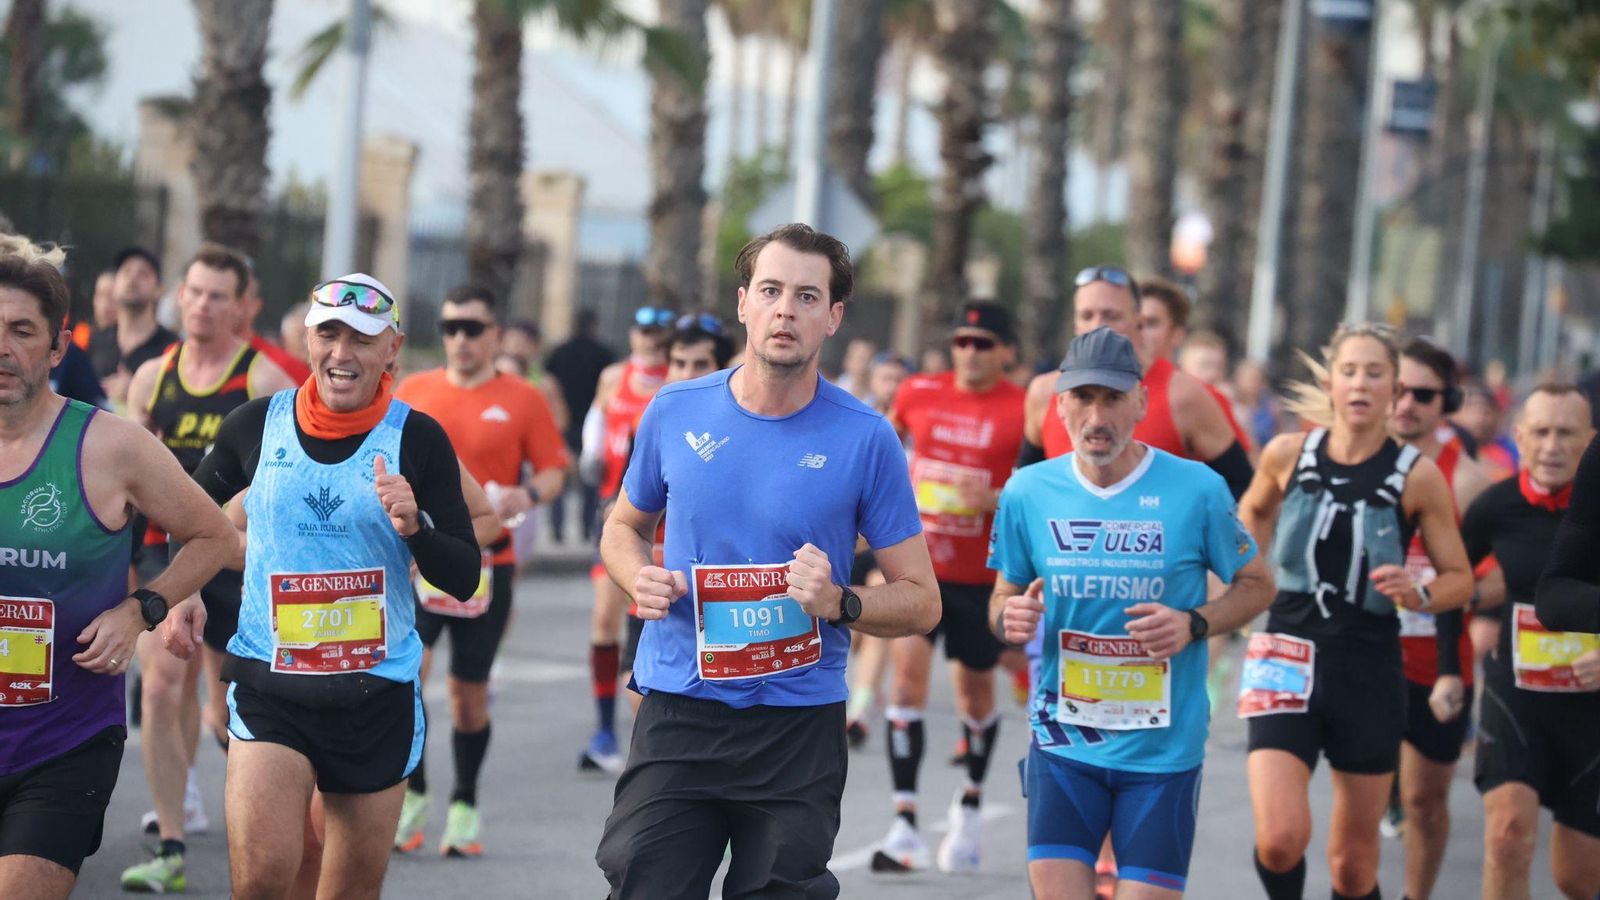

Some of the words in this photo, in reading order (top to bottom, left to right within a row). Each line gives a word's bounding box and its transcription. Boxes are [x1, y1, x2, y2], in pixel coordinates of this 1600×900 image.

[264, 461, 294, 469] VIATOR
[21, 486, 45, 514] DACORUM
[1139, 496, 1160, 507] HH
[298, 523, 319, 532] CAJA
[320, 523, 349, 533] RURAL
[1104, 521, 1162, 531] COMERCIAL
[1104, 533, 1163, 553] ULSA
[1102, 558, 1164, 569] INDUSTRIALES
[727, 570, 788, 588] GENERA
[1051, 574, 1165, 600] ATLETISMO
[302, 607, 353, 628] 2701
[729, 605, 785, 628] 1091
[748, 629, 770, 637] TIMO
[351, 647, 371, 655] 42K
[783, 642, 806, 653] 42K
[1081, 668, 1146, 689] 11779
[9, 682, 32, 690] 42K
